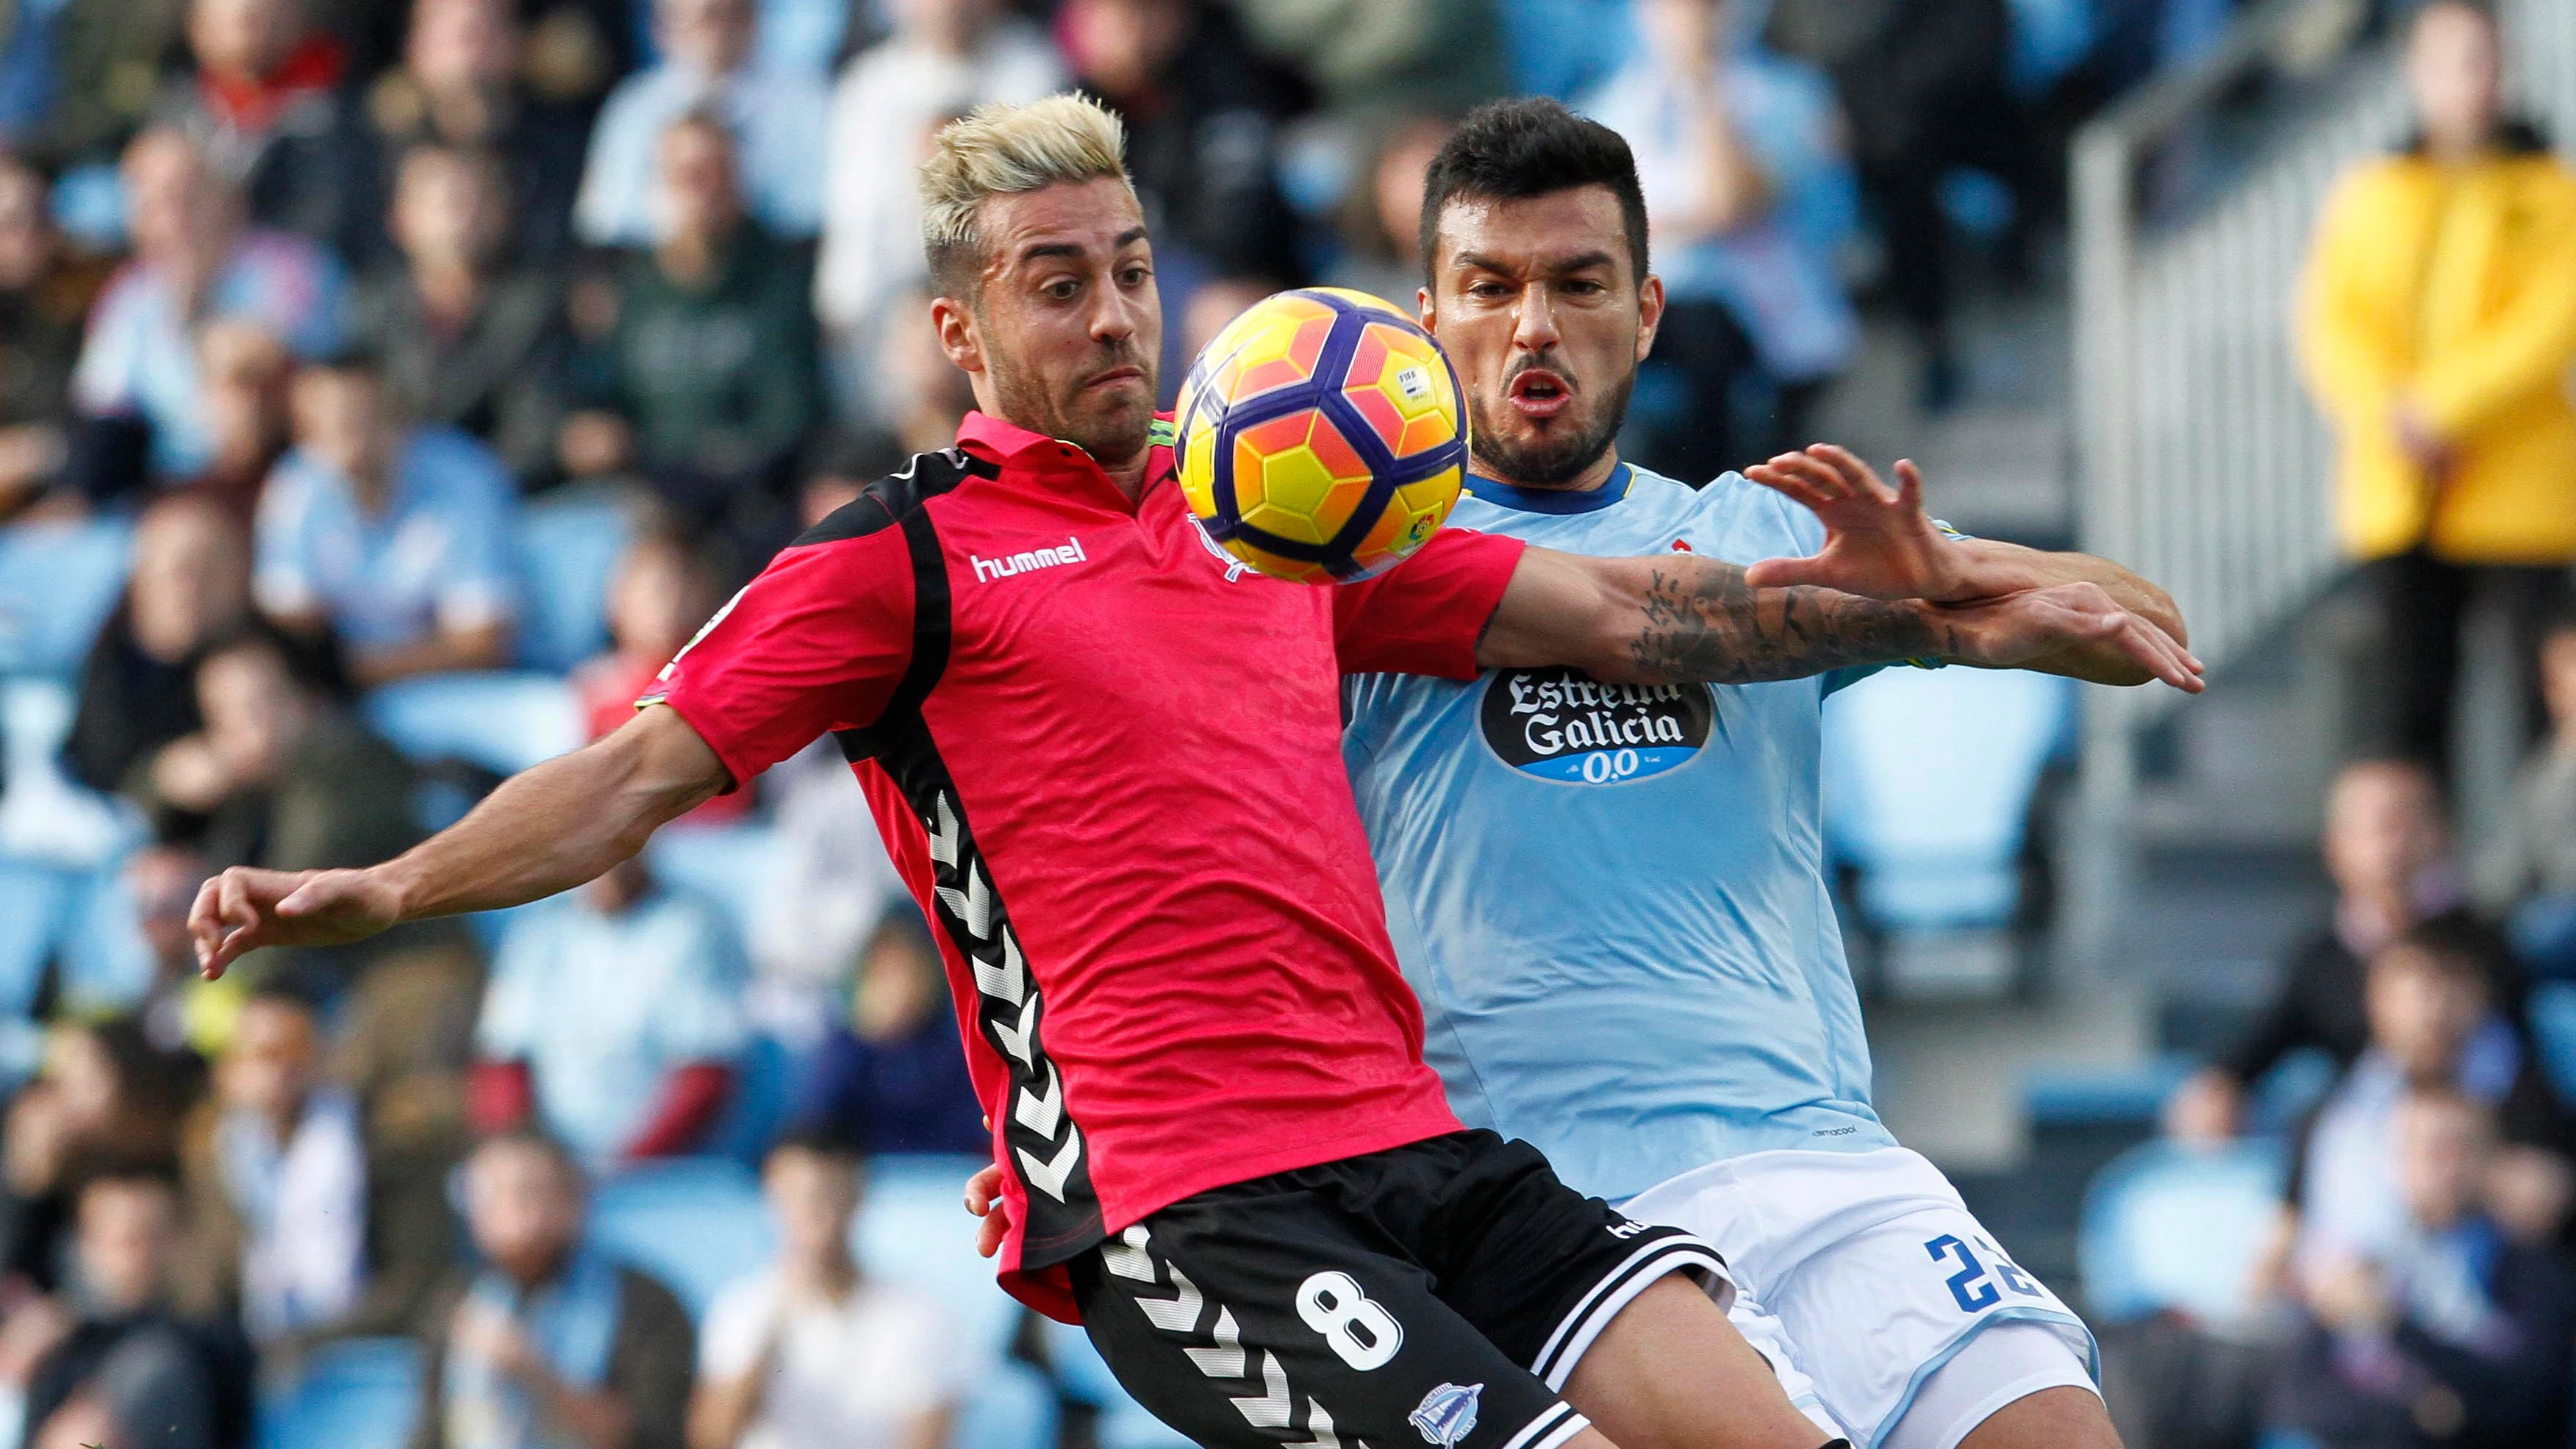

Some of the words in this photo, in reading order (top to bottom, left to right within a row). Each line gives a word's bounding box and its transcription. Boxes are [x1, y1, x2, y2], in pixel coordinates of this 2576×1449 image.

[1399, 371, 1416, 382] FIFA
[970, 536, 1087, 583] hummel
[1525, 707, 1684, 755] Galicia
[1582, 748, 1639, 784] 0,0
[1295, 1270, 1404, 1371] 8
